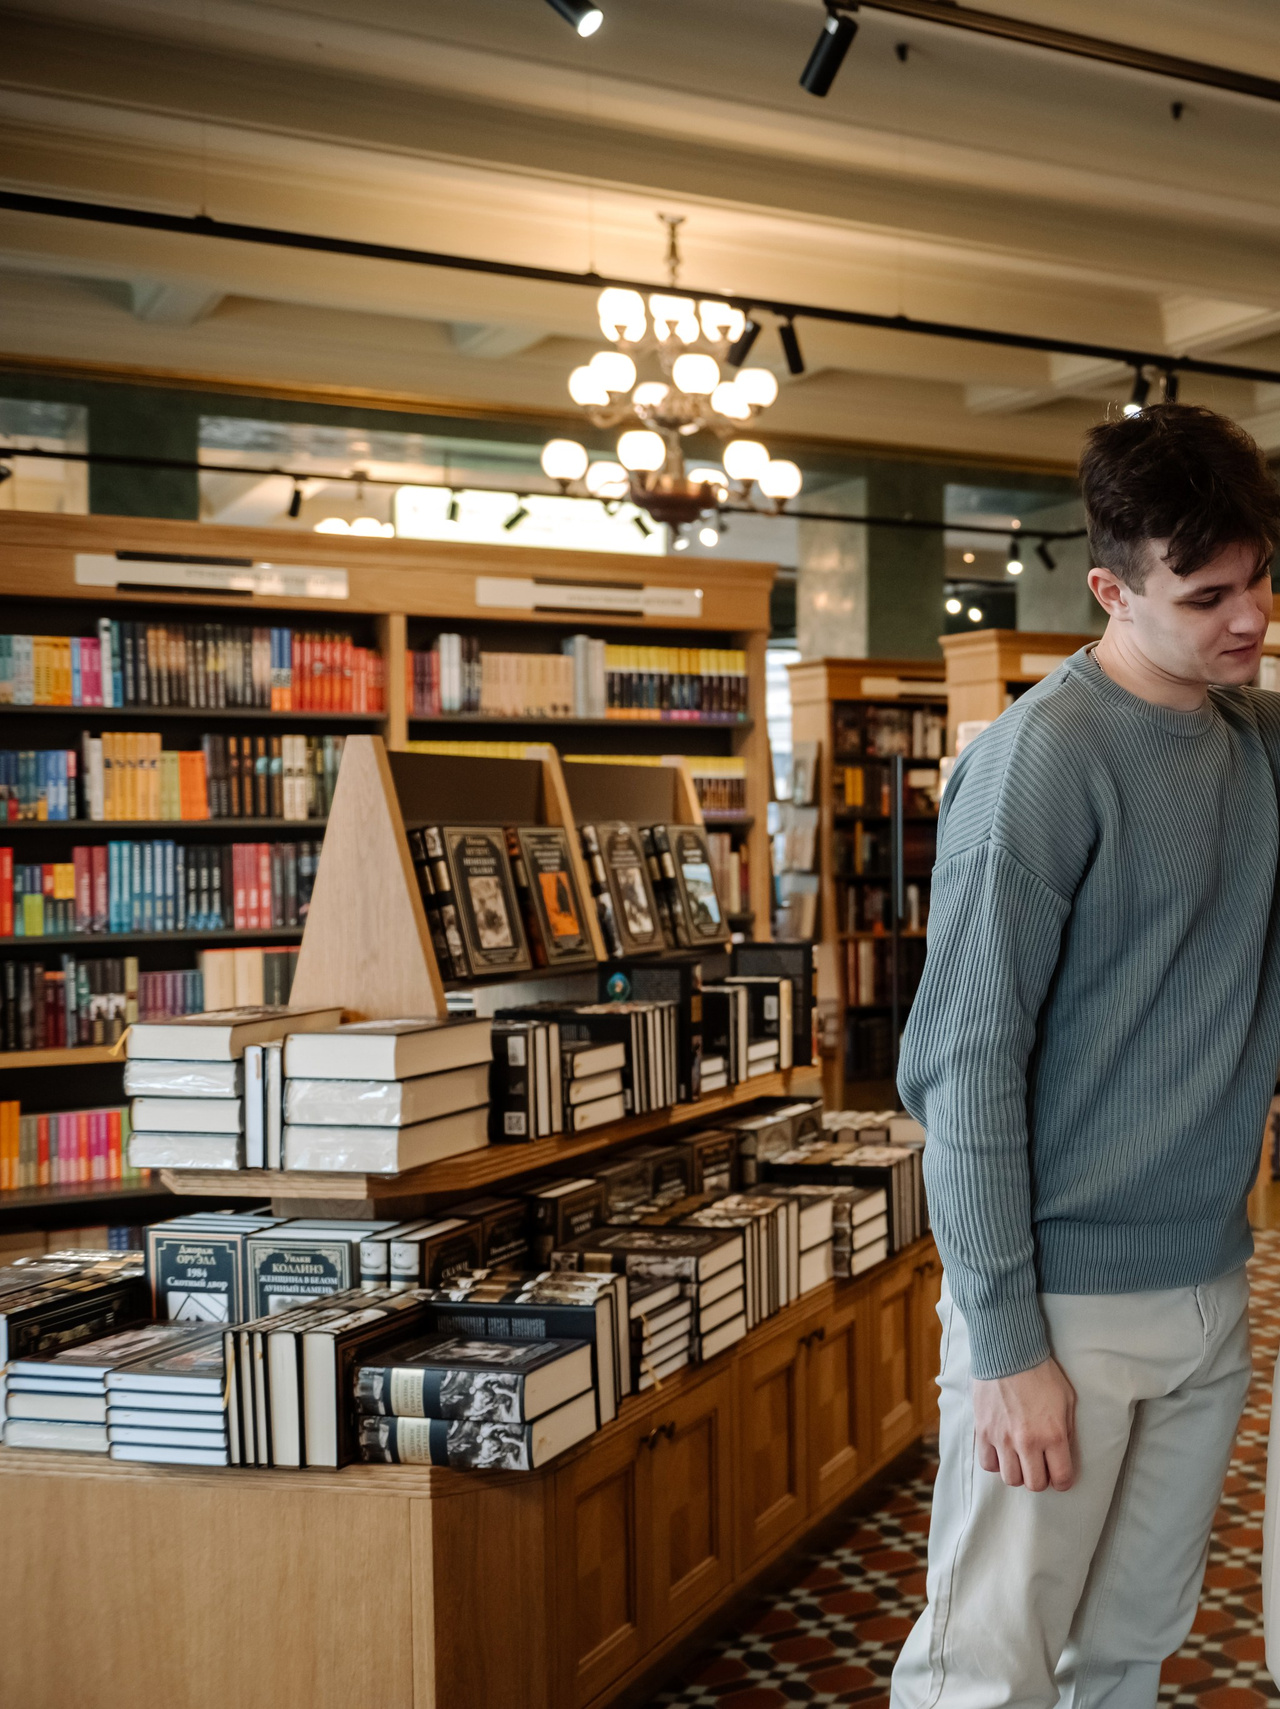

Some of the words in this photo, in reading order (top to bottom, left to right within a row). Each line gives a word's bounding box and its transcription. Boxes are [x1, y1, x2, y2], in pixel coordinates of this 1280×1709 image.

[176, 1255, 216, 1266] ОРУЭЛЛ
[186, 1267, 208, 1278] 1984
[272, 1263, 324, 1274] КОЛЛИНЗ
[166, 1276, 206, 1288] Скотный
[207, 1279, 229, 1292] двор
[259, 1274, 303, 1285] ЖЕНЩИНА
[304, 1275, 310, 1285] В
[310, 1276, 338, 1286] БЕЛОМ
[263, 1284, 299, 1293] ЛУННЫЙ
[300, 1285, 334, 1295] КАМЕНЬ
